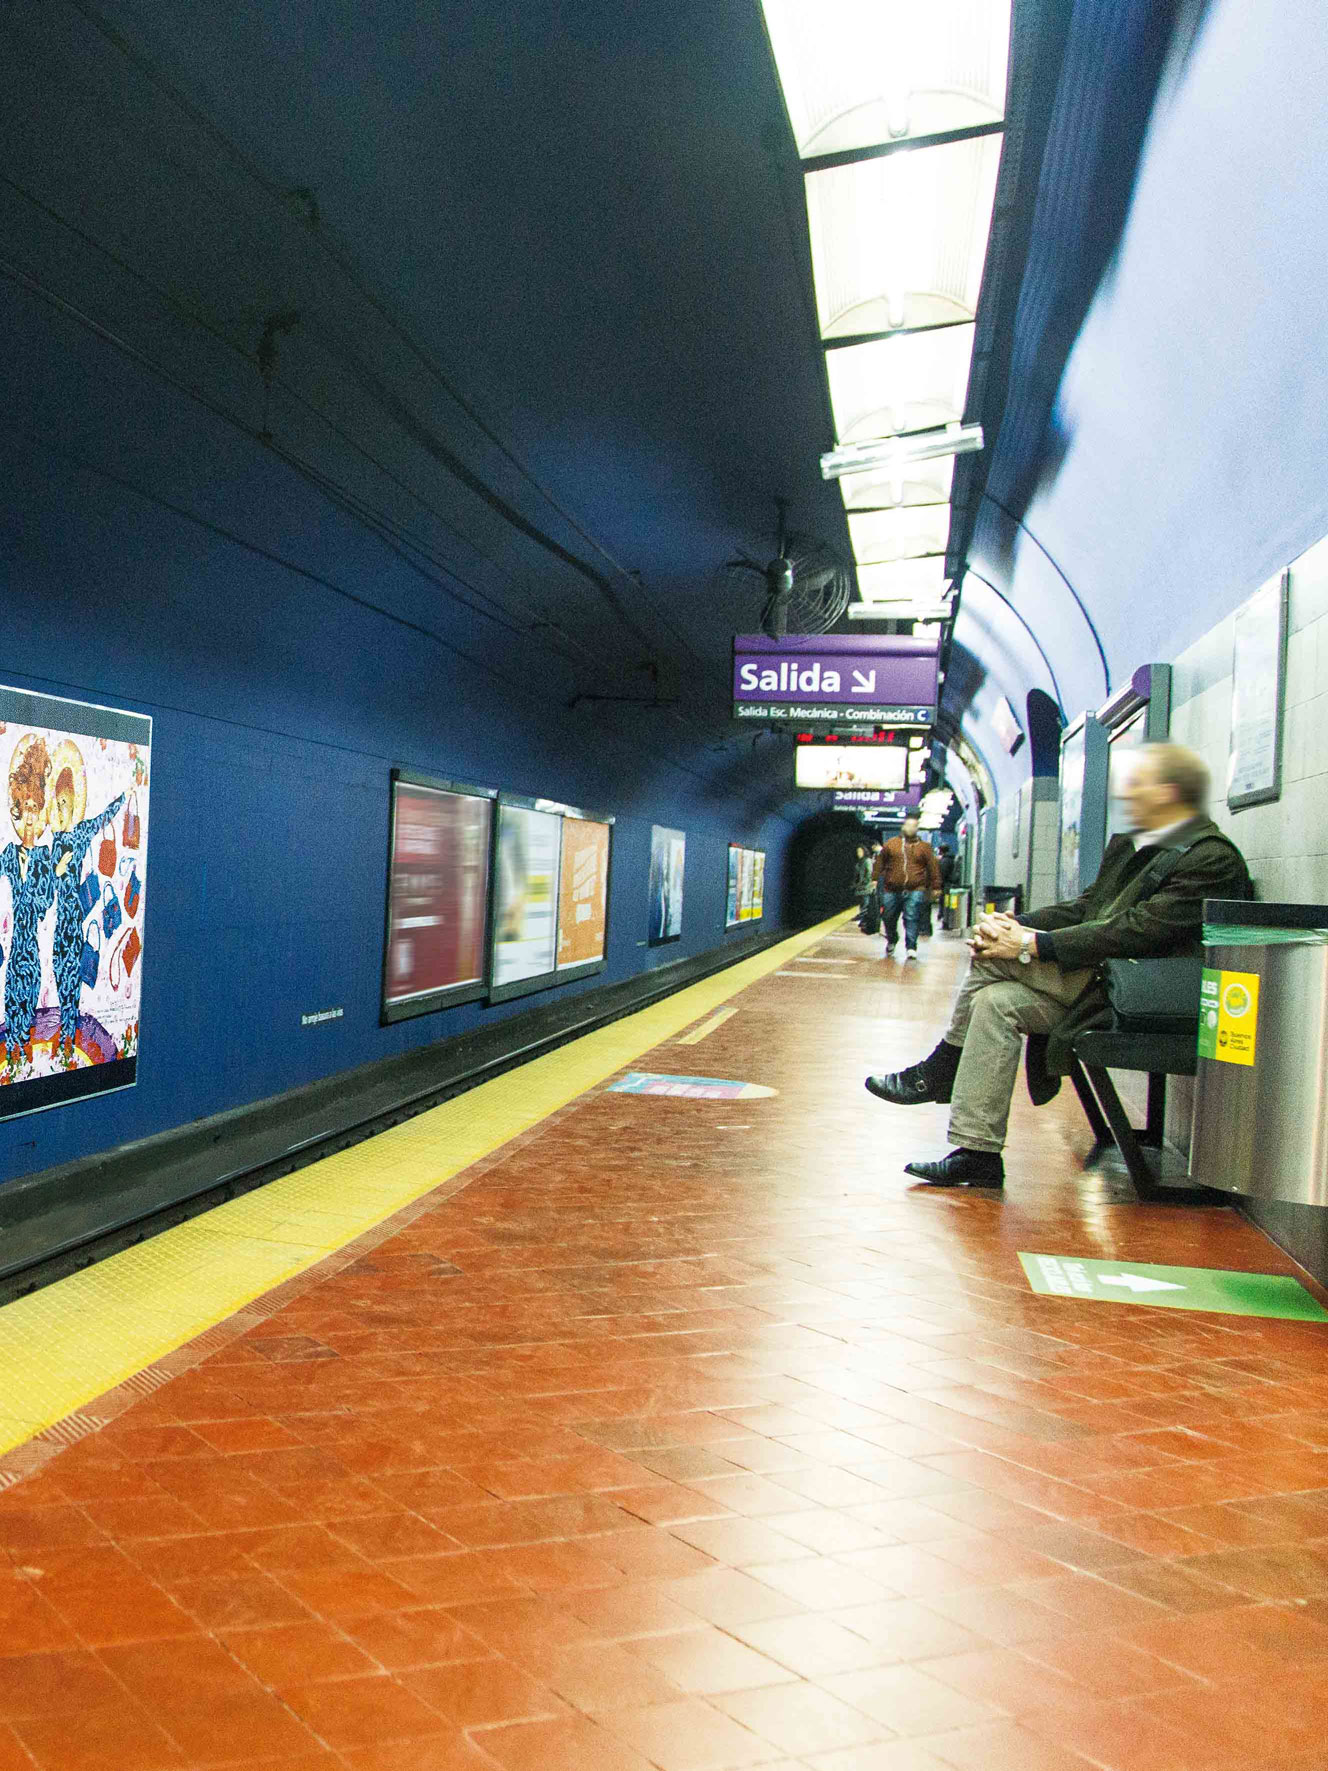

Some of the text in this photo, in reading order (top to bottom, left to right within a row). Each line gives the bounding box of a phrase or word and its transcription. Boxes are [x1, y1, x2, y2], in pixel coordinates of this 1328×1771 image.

[740, 662, 841, 693] Salida
[738, 706, 768, 717] Salida
[770, 707, 788, 718] Esc.
[790, 707, 838, 719] Mecánica
[845, 708, 915, 721] Combinación
[917, 710, 927, 721] C
